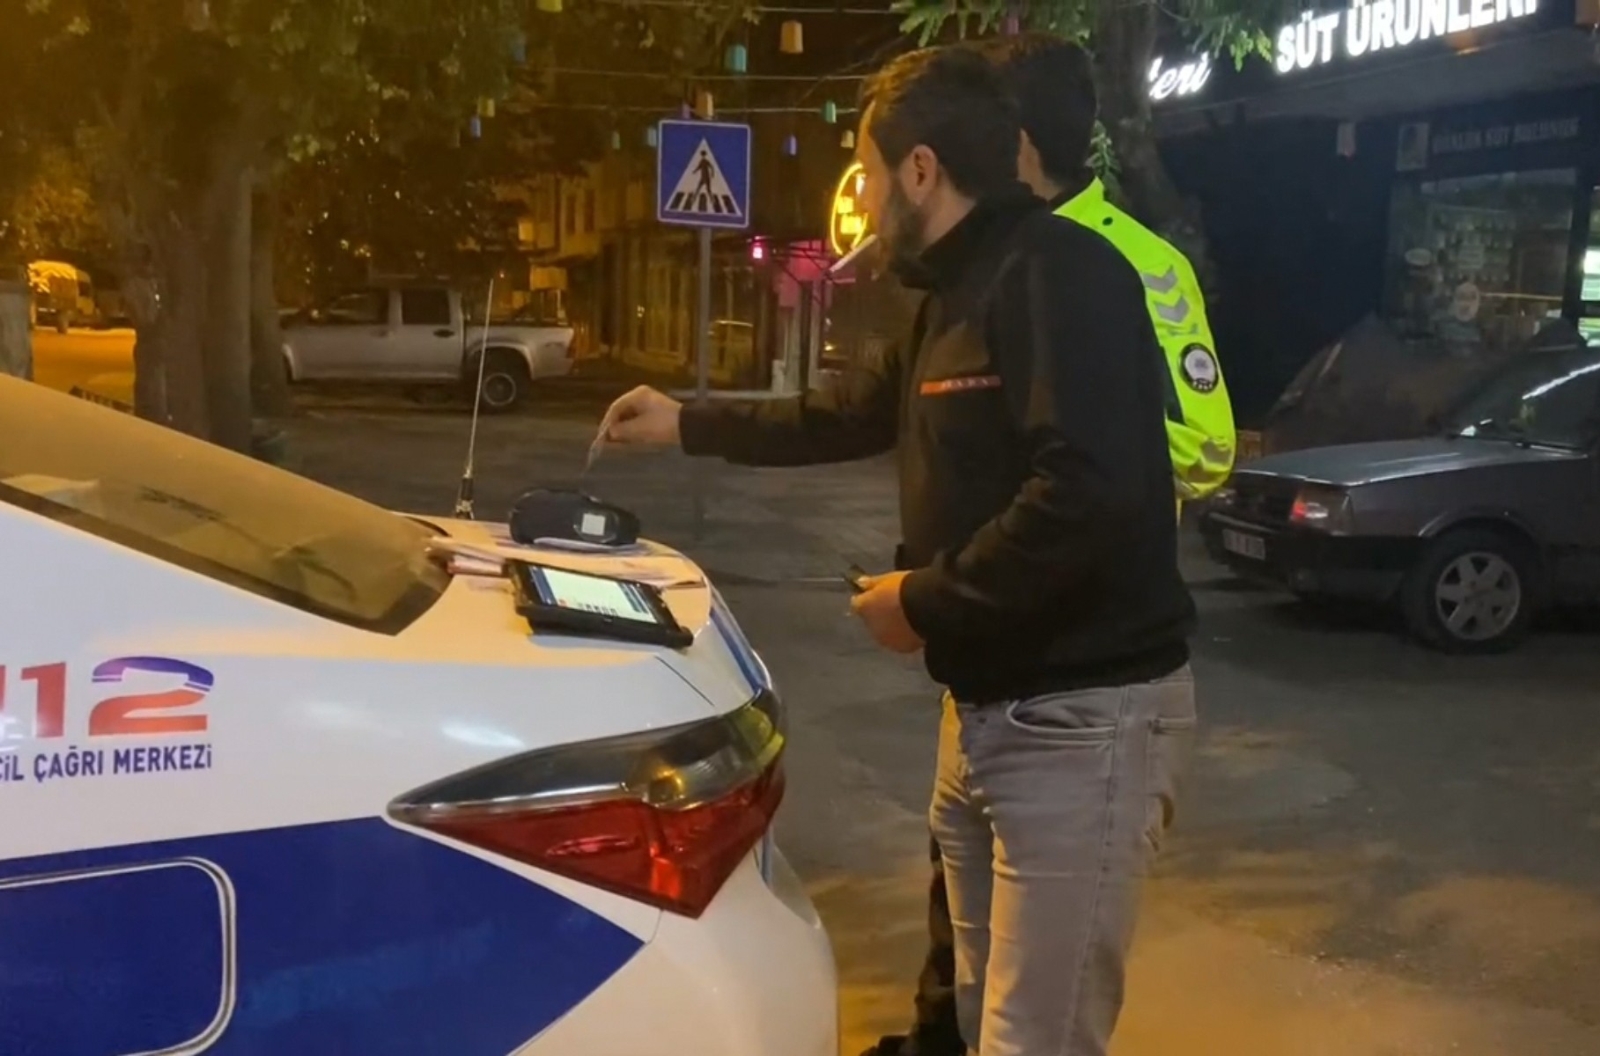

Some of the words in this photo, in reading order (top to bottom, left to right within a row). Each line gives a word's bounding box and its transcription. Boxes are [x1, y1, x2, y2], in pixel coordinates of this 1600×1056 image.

[1276, 10, 1340, 73] SÜT
[0, 656, 214, 739] 12
[0, 754, 25, 782] İL
[33, 746, 104, 783] ÇAĞRI
[113, 744, 212, 775] MERKEZİ
